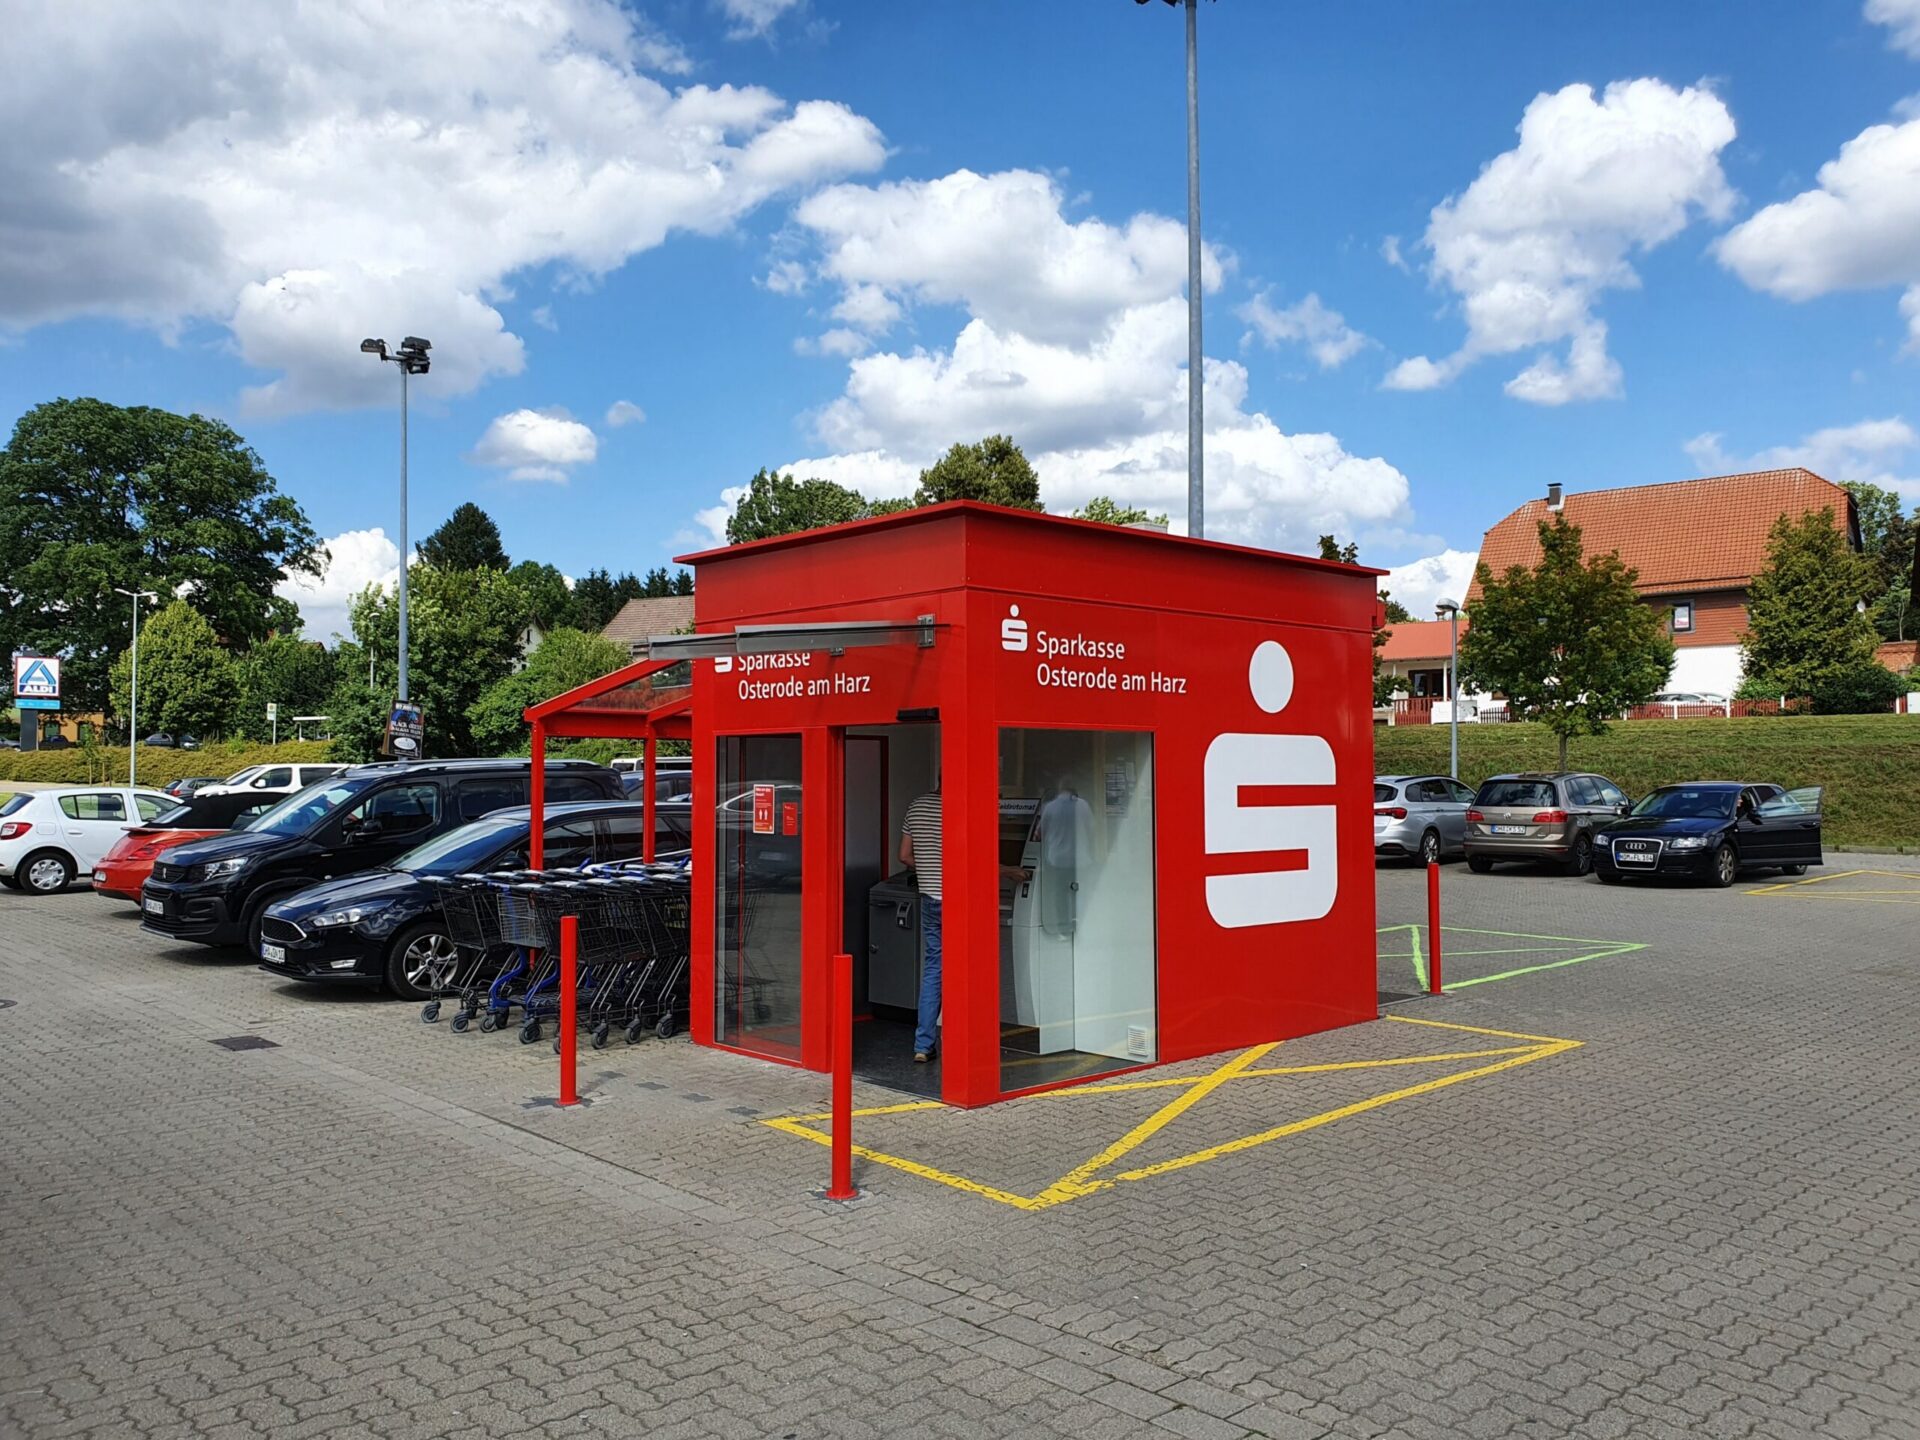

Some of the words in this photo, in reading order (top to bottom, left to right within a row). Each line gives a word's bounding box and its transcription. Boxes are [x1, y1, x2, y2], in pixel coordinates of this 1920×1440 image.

[1036, 630, 1125, 660] Sparkasse
[22, 684, 53, 694] ALDI
[738, 675, 804, 700] Osterode
[807, 679, 830, 696] am
[834, 672, 871, 694] Harz
[1036, 662, 1117, 690] Osterode
[1121, 673, 1146, 691] am
[1151, 671, 1187, 694] Harz
